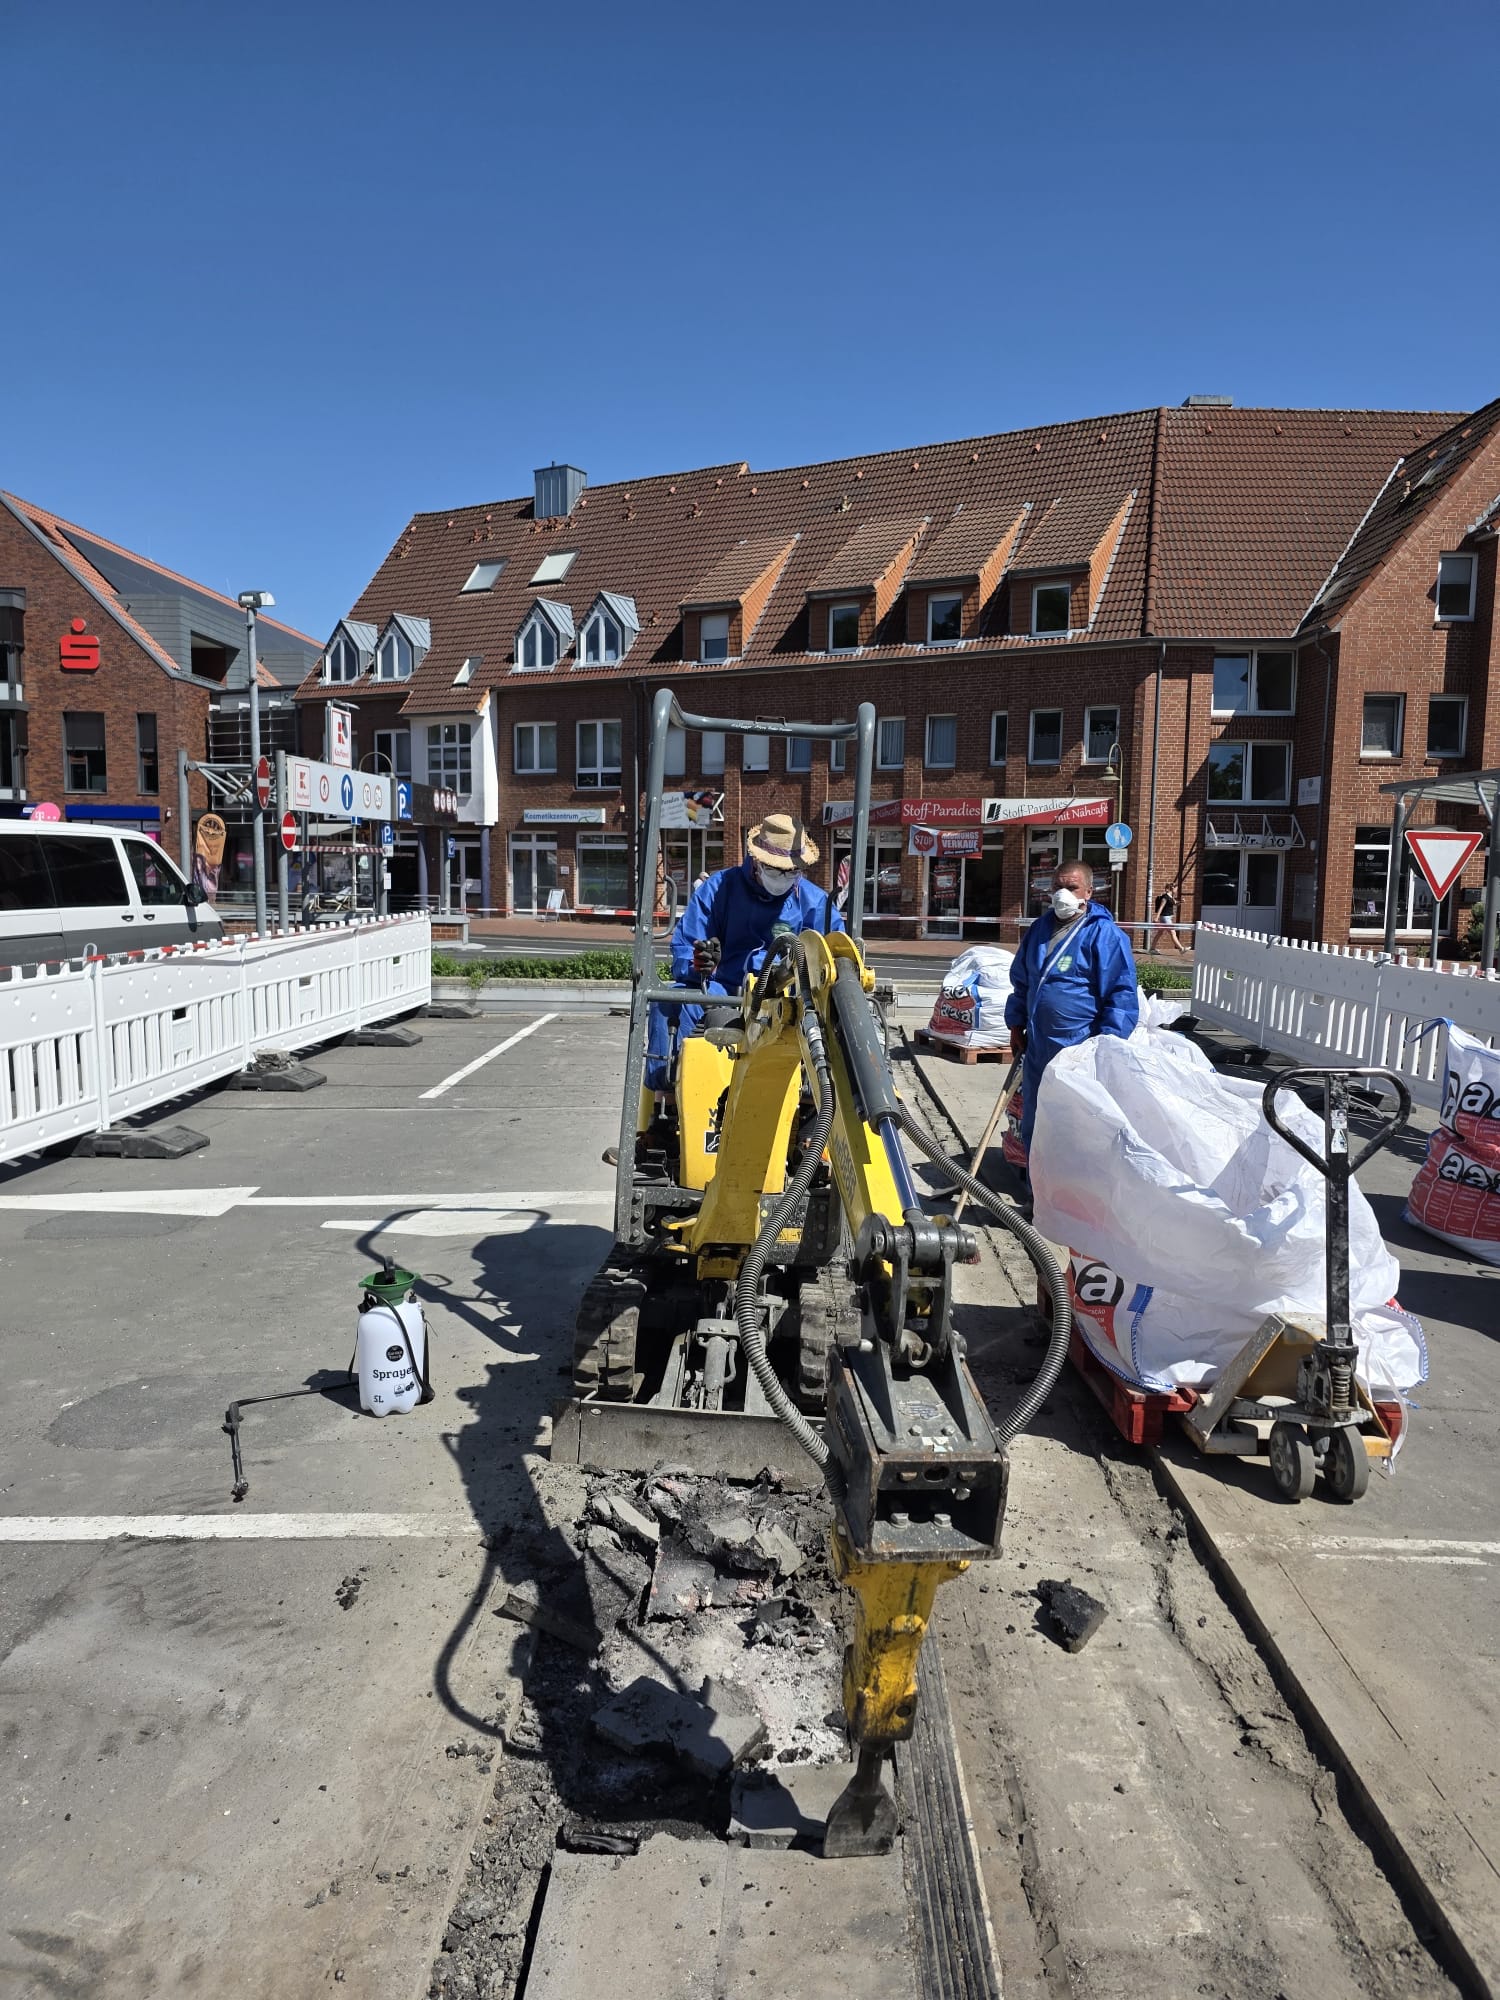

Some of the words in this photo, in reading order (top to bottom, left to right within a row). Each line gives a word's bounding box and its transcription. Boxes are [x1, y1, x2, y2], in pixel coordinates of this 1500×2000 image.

[525, 811, 579, 820] Kosmetikzentrum
[902, 801, 981, 820] Stoff-Paradies
[1002, 799, 1068, 819] Stoff-Paradies
[384, 825, 391, 842] P
[914, 834, 934, 845] STOP
[942, 839, 978, 849] VERKAUF
[1080, 1266, 1117, 1303] a
